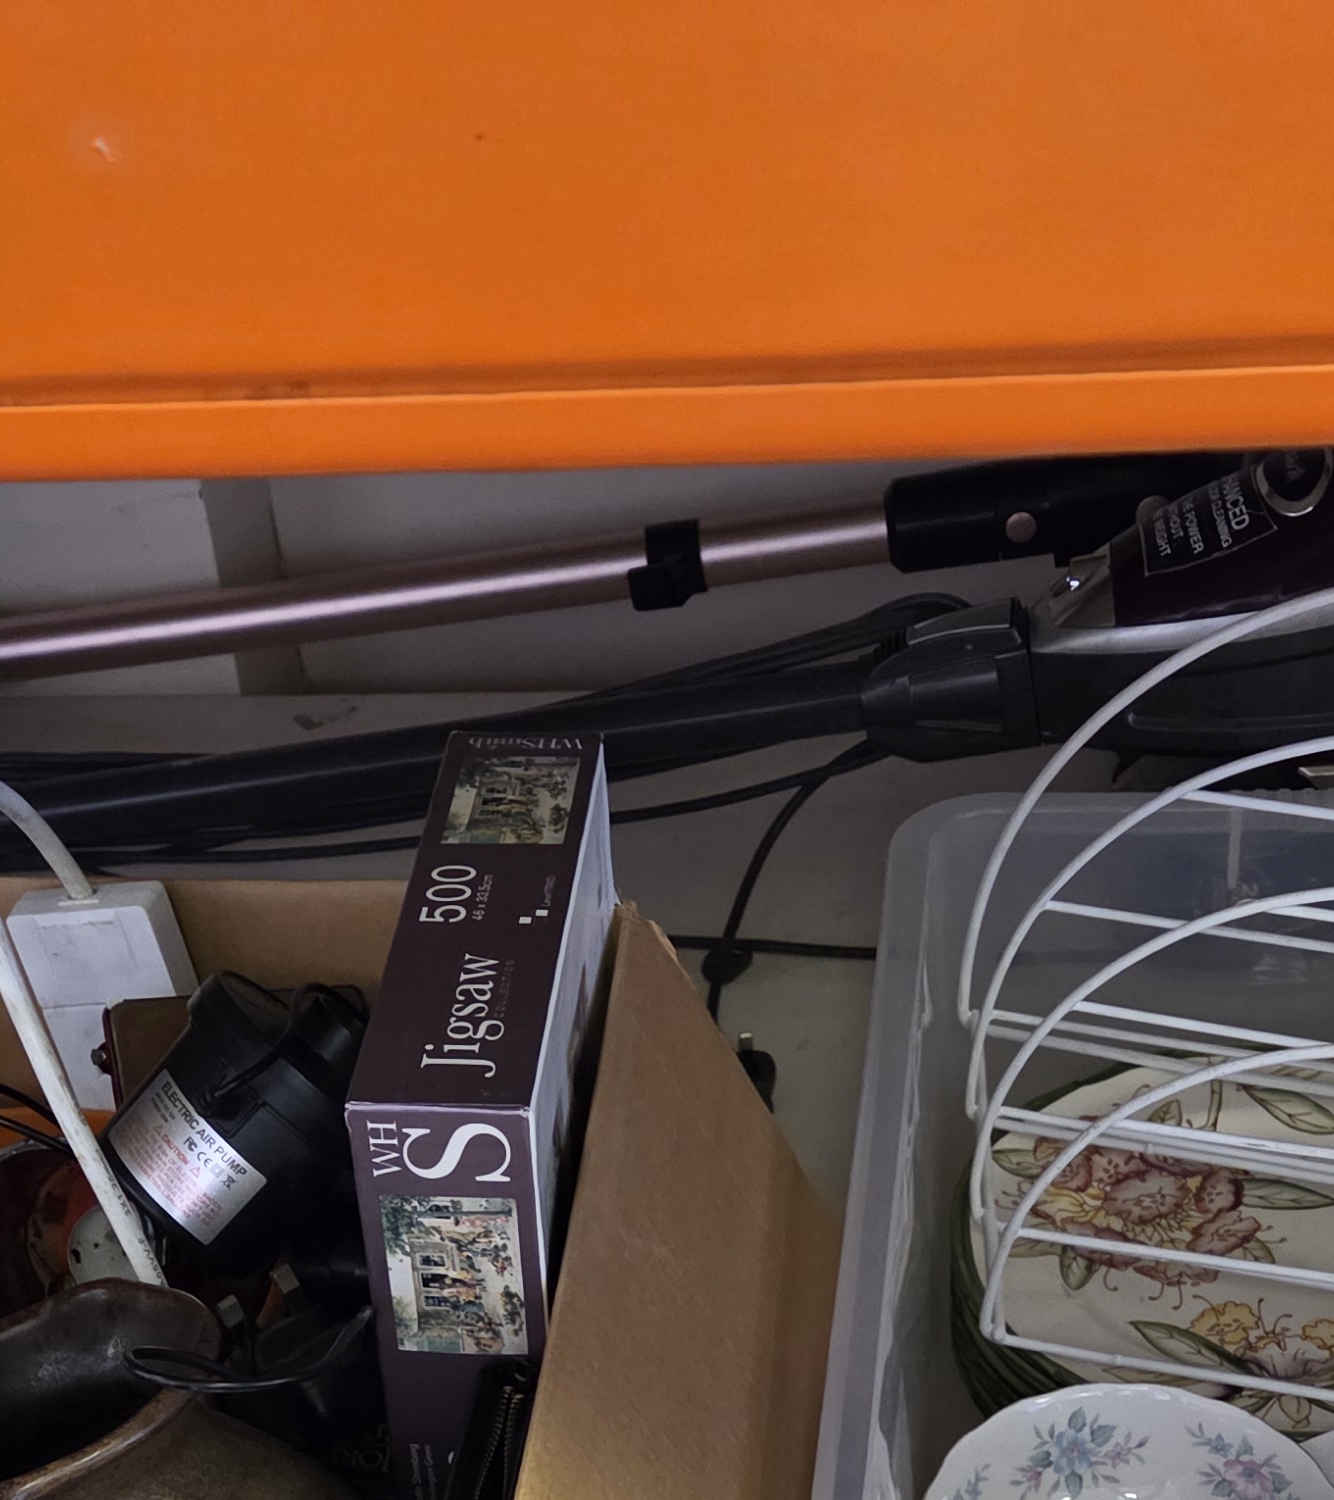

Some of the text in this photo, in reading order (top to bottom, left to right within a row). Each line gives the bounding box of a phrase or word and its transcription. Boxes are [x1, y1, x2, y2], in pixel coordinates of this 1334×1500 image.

[1184, 511, 1205, 554] POWER
[419, 865, 505, 1078] Jigsaw 500
[160, 1081, 200, 1131] ELECTRIC
[197, 1127, 218, 1151] AIR
[214, 1145, 248, 1178] PUMP
[160, 1133, 190, 1166] CAUTION
[365, 1120, 512, 1184] WH S
